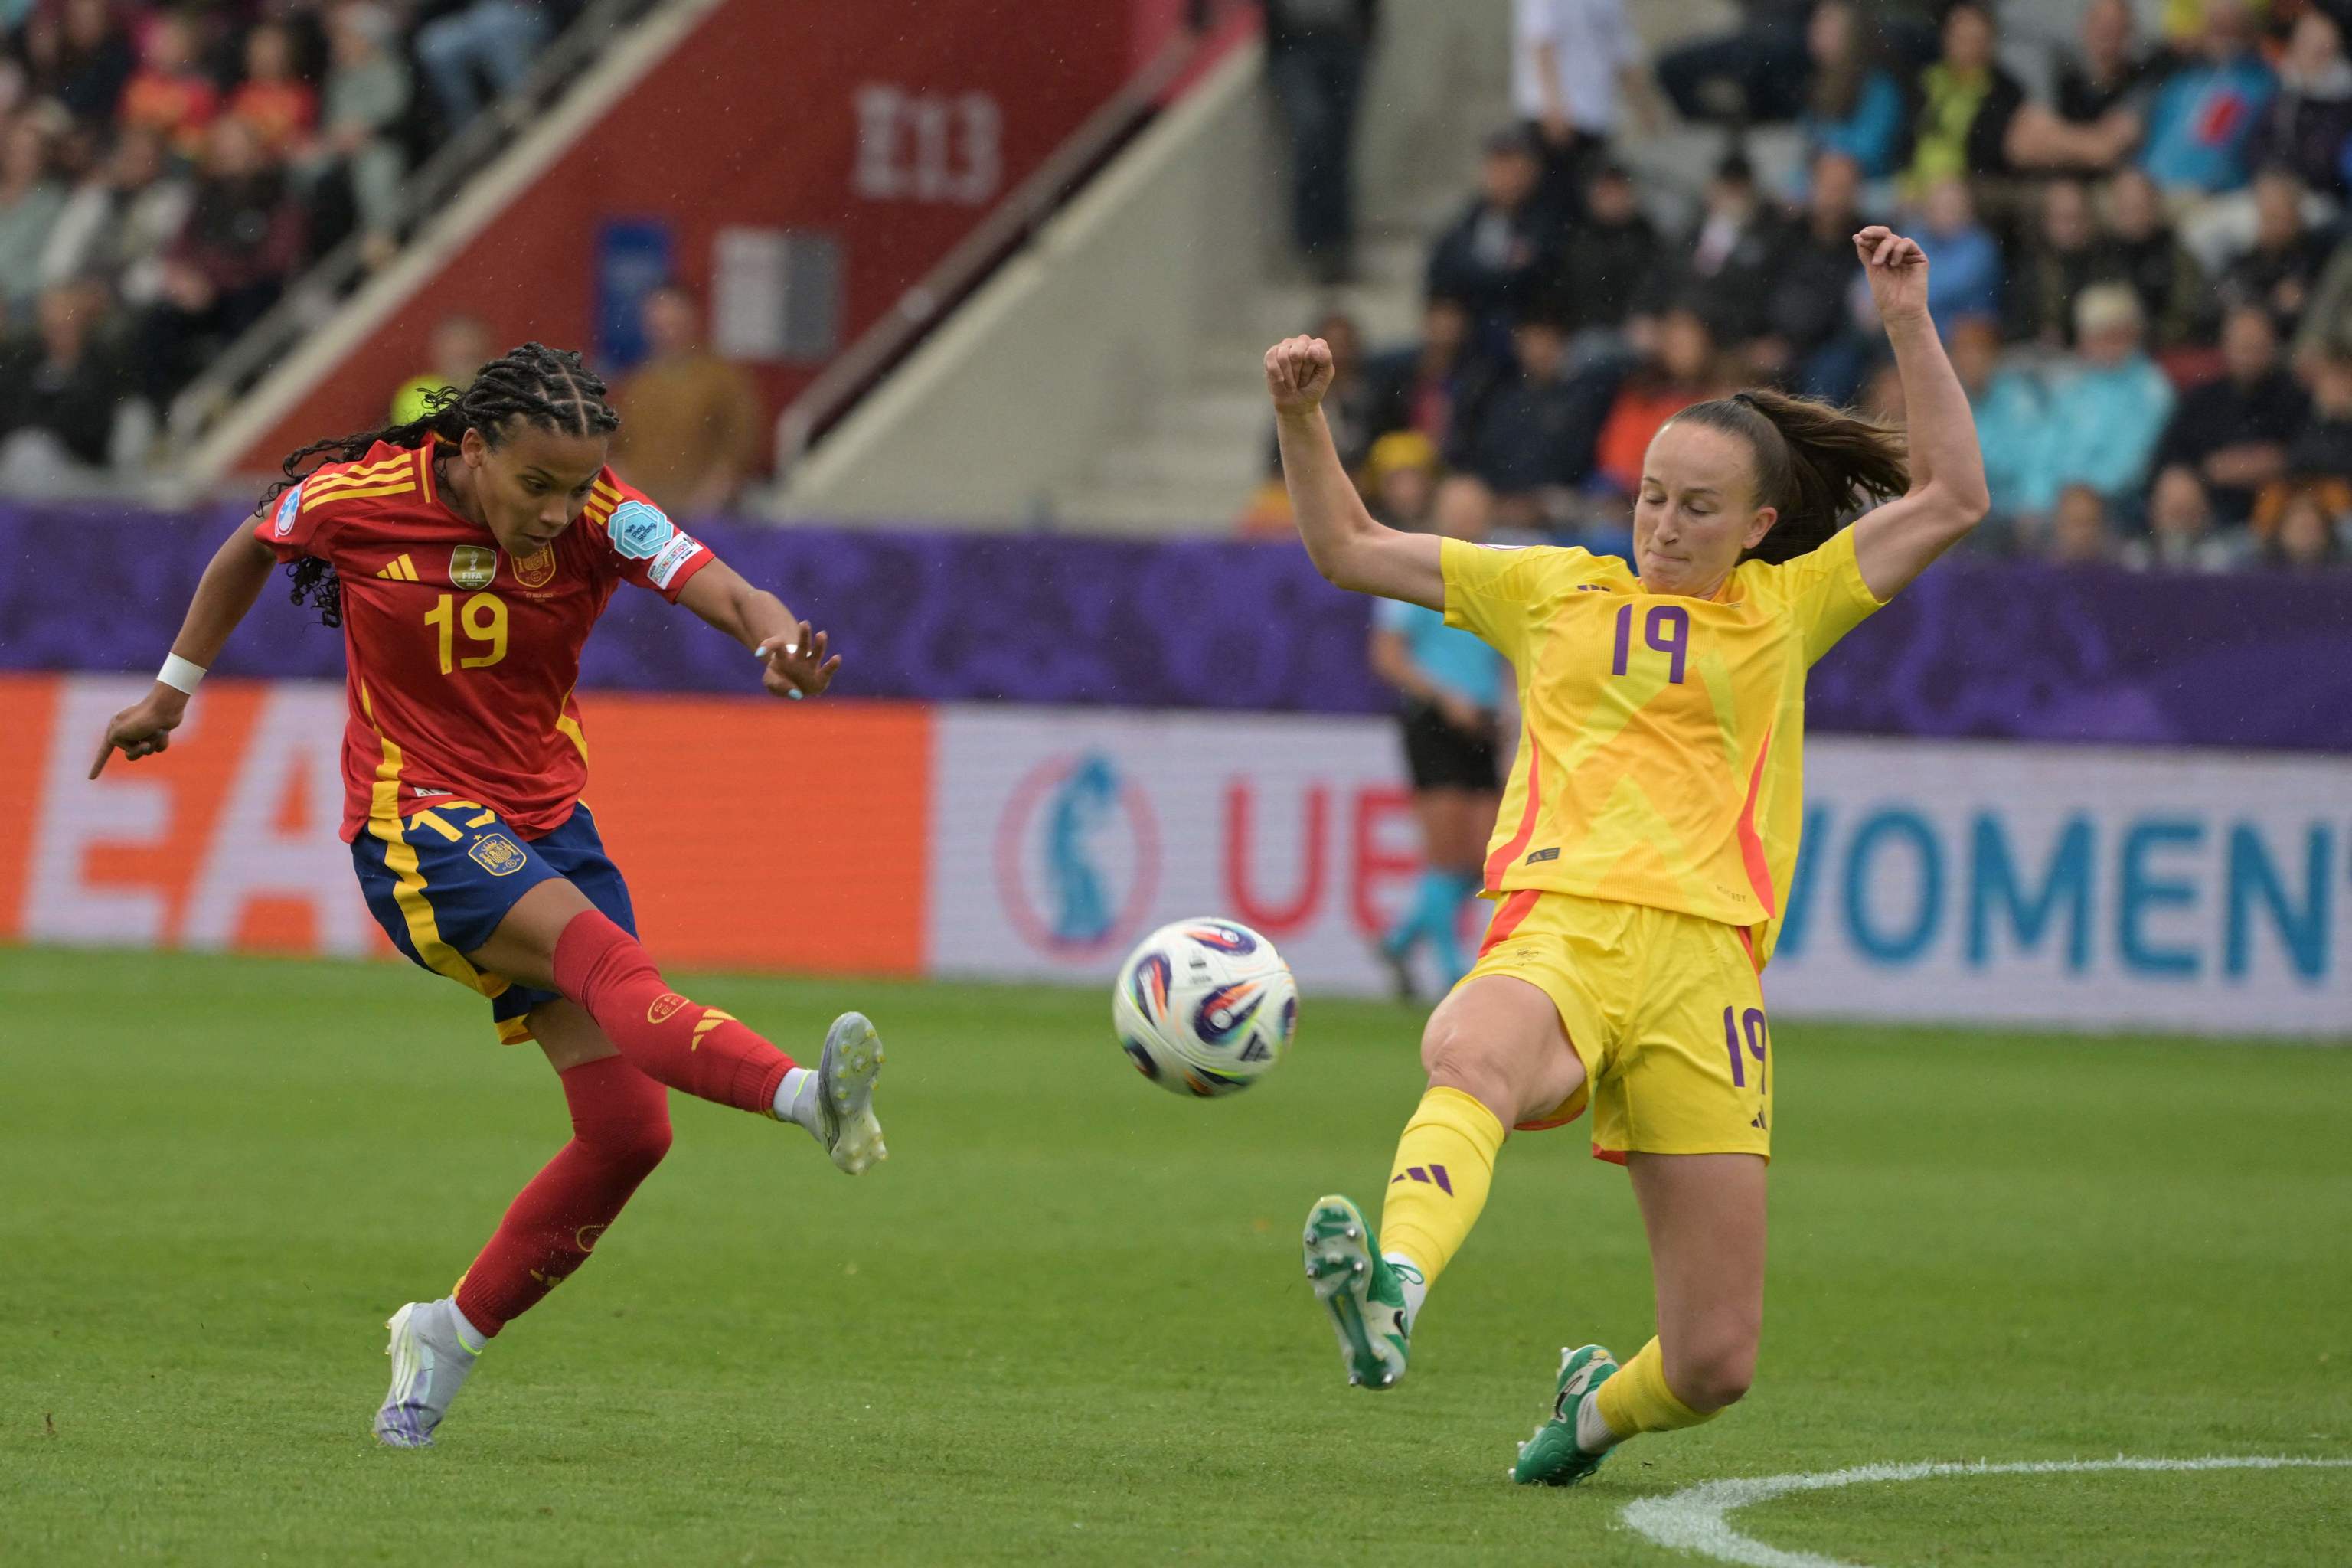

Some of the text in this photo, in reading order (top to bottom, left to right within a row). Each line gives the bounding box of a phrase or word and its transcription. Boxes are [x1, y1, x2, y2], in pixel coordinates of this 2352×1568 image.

[425, 592, 508, 675] 19
[1612, 603, 1690, 684] 19
[1219, 779, 1479, 945] UE
[1723, 1005, 1766, 1096] 19
